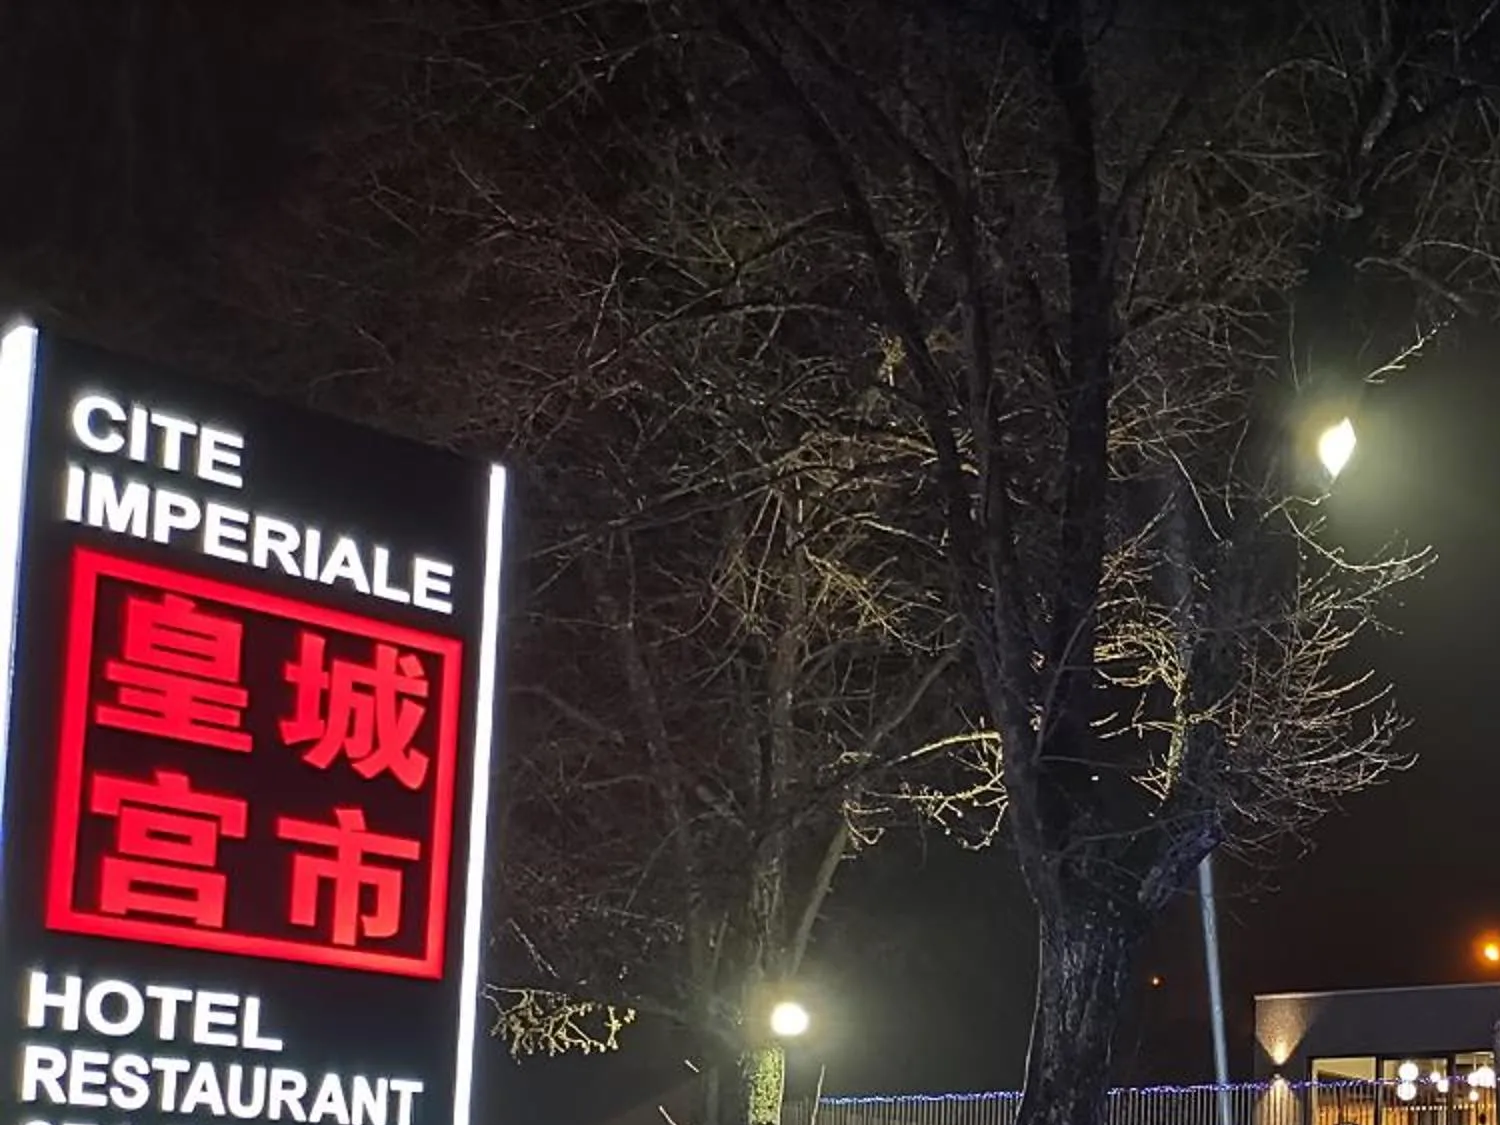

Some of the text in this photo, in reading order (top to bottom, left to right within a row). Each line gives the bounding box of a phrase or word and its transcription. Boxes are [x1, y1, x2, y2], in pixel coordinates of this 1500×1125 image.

[71, 393, 244, 488] CITE
[64, 463, 454, 614] IMPERIALE
[27, 970, 283, 1051] HOTEL
